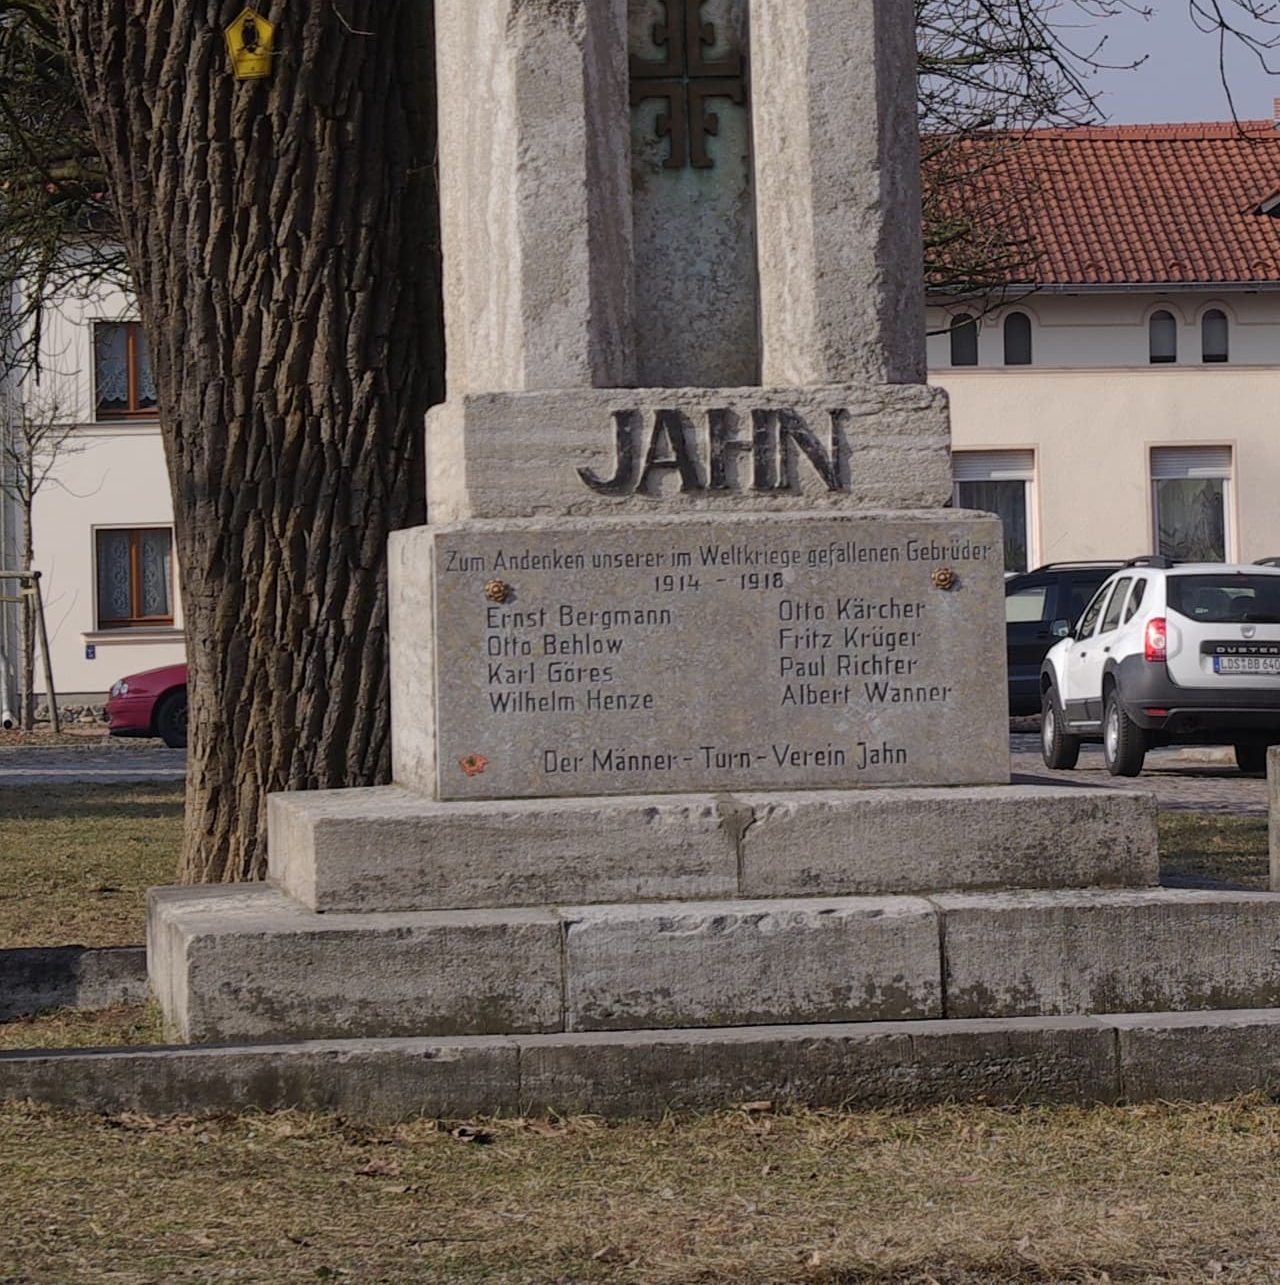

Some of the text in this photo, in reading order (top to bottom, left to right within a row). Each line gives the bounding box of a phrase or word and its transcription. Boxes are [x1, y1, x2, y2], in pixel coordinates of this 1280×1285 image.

[576, 407, 850, 496] JAHN
[446, 539, 992, 573] Zum Andenken unserer im Weltkriege gefallenen Gebrüder
[654, 574, 702, 592] 1914
[740, 572, 785, 590] 1918
[486, 604, 672, 631] Ernst Bergmann
[778, 597, 926, 621] Otto Kärcher
[487, 633, 624, 657] Otto Behlow
[778, 626, 921, 652] Fritz Krüger
[1215, 646, 1279, 654] DUSTER
[488, 661, 614, 685] Karl Göres
[780, 654, 918, 677] Paul Richter
[1220, 658, 1241, 671] LDS
[489, 689, 654, 713] Wilhelm Henze
[781, 681, 953, 706] Albert Wanner
[544, 750, 583, 774] Der
[857, 742, 908, 770] Jahn
